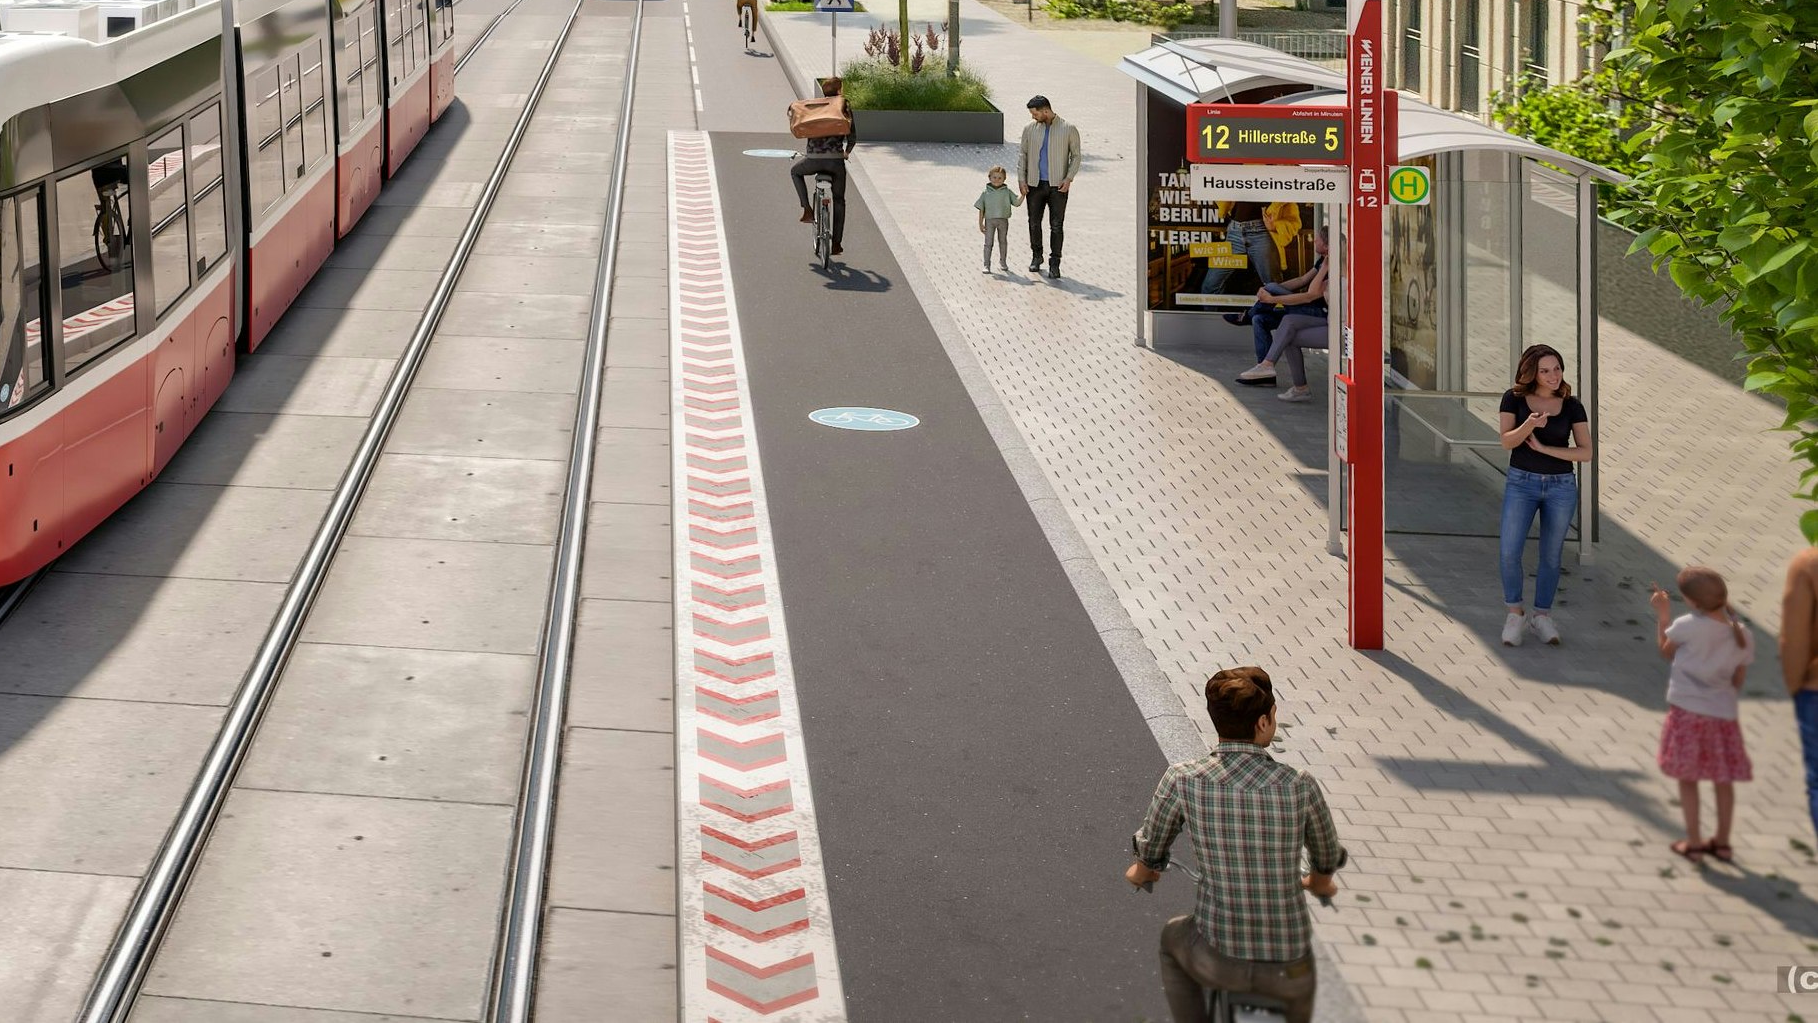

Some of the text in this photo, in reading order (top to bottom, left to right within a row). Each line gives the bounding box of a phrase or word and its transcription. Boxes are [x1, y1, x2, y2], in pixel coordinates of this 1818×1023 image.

[1360, 39, 1373, 144] WIENER LINIEN
[1202, 125, 1339, 152] 12 Hillerstraße 5
[1203, 176, 1336, 191] Haussteinstraße
[1399, 175, 1418, 196] H
[1159, 189, 1191, 205] WIE
[1356, 195, 1378, 208] 12
[1159, 207, 1225, 223] BERLIN.
[1159, 230, 1212, 245] LEBEN
[1194, 243, 1229, 256] wie in
[1212, 256, 1244, 267] Wien
